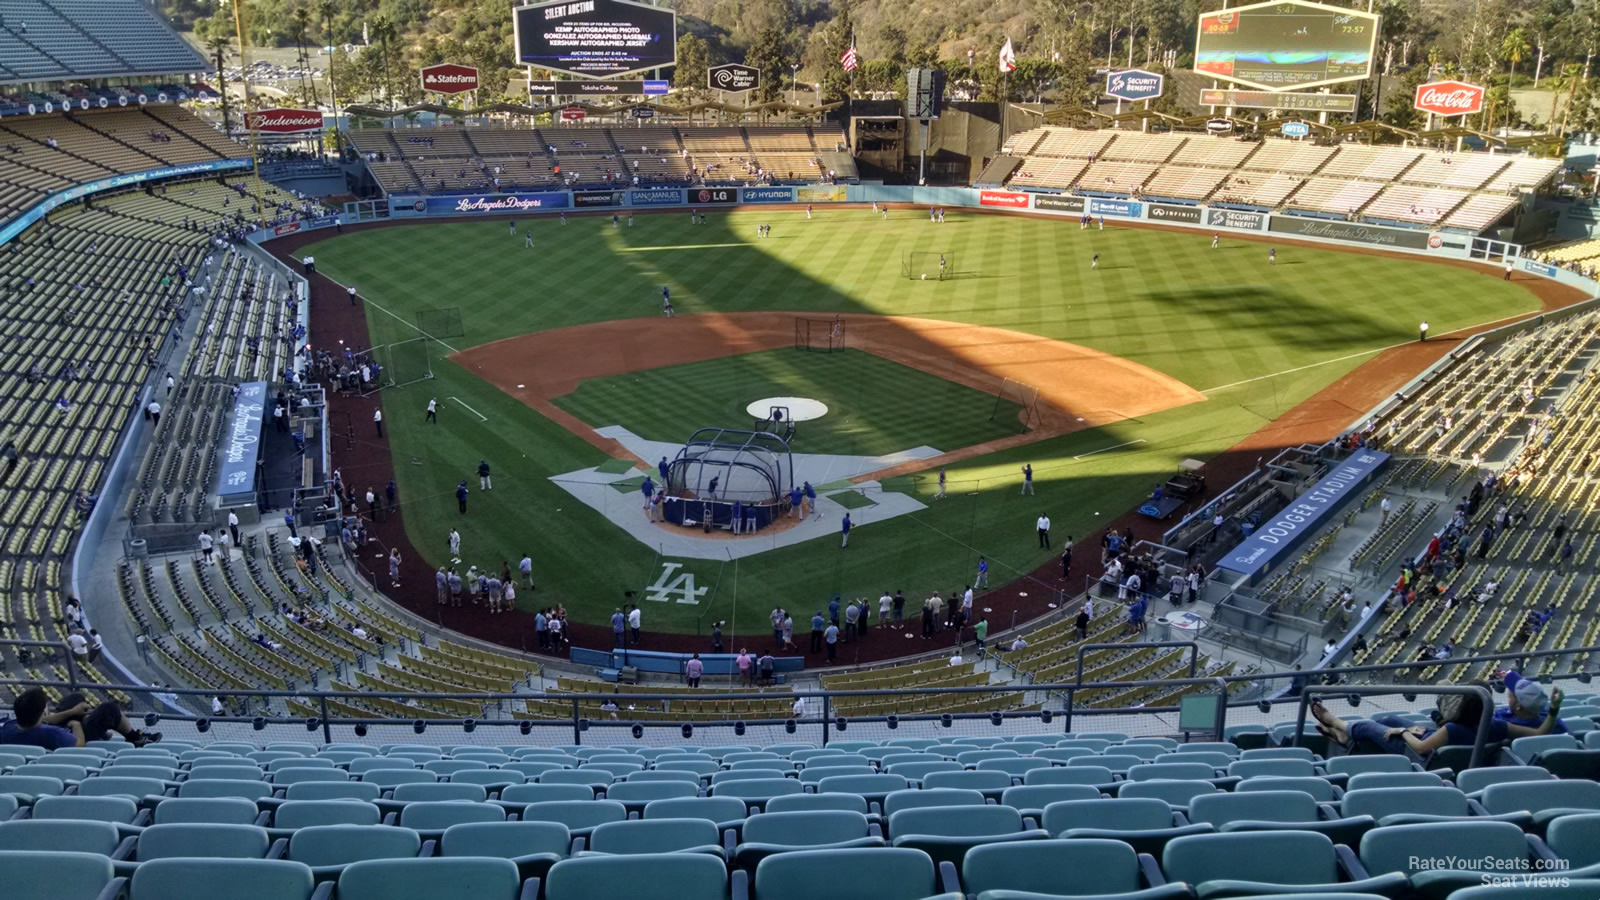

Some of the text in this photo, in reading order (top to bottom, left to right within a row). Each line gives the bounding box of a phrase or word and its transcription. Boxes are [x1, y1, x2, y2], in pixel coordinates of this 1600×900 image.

[545, 0, 594, 20] SILENT AUCTION
[1276, 6, 1296, 14] 5:47
[438, 75, 476, 83] State Farm
[1421, 88, 1477, 108] Coca-Cola
[251, 114, 321, 127] Budweiser
[455, 196, 541, 211] Los Angeles Dodgers
[1226, 220, 1254, 228] BENEFIT
[1227, 212, 1259, 222] SECURITY
[1299, 222, 1395, 243] Los Angeles Dodgers
[1259, 466, 1363, 544] DODGER STADIUM
[646, 562, 708, 605] LA
